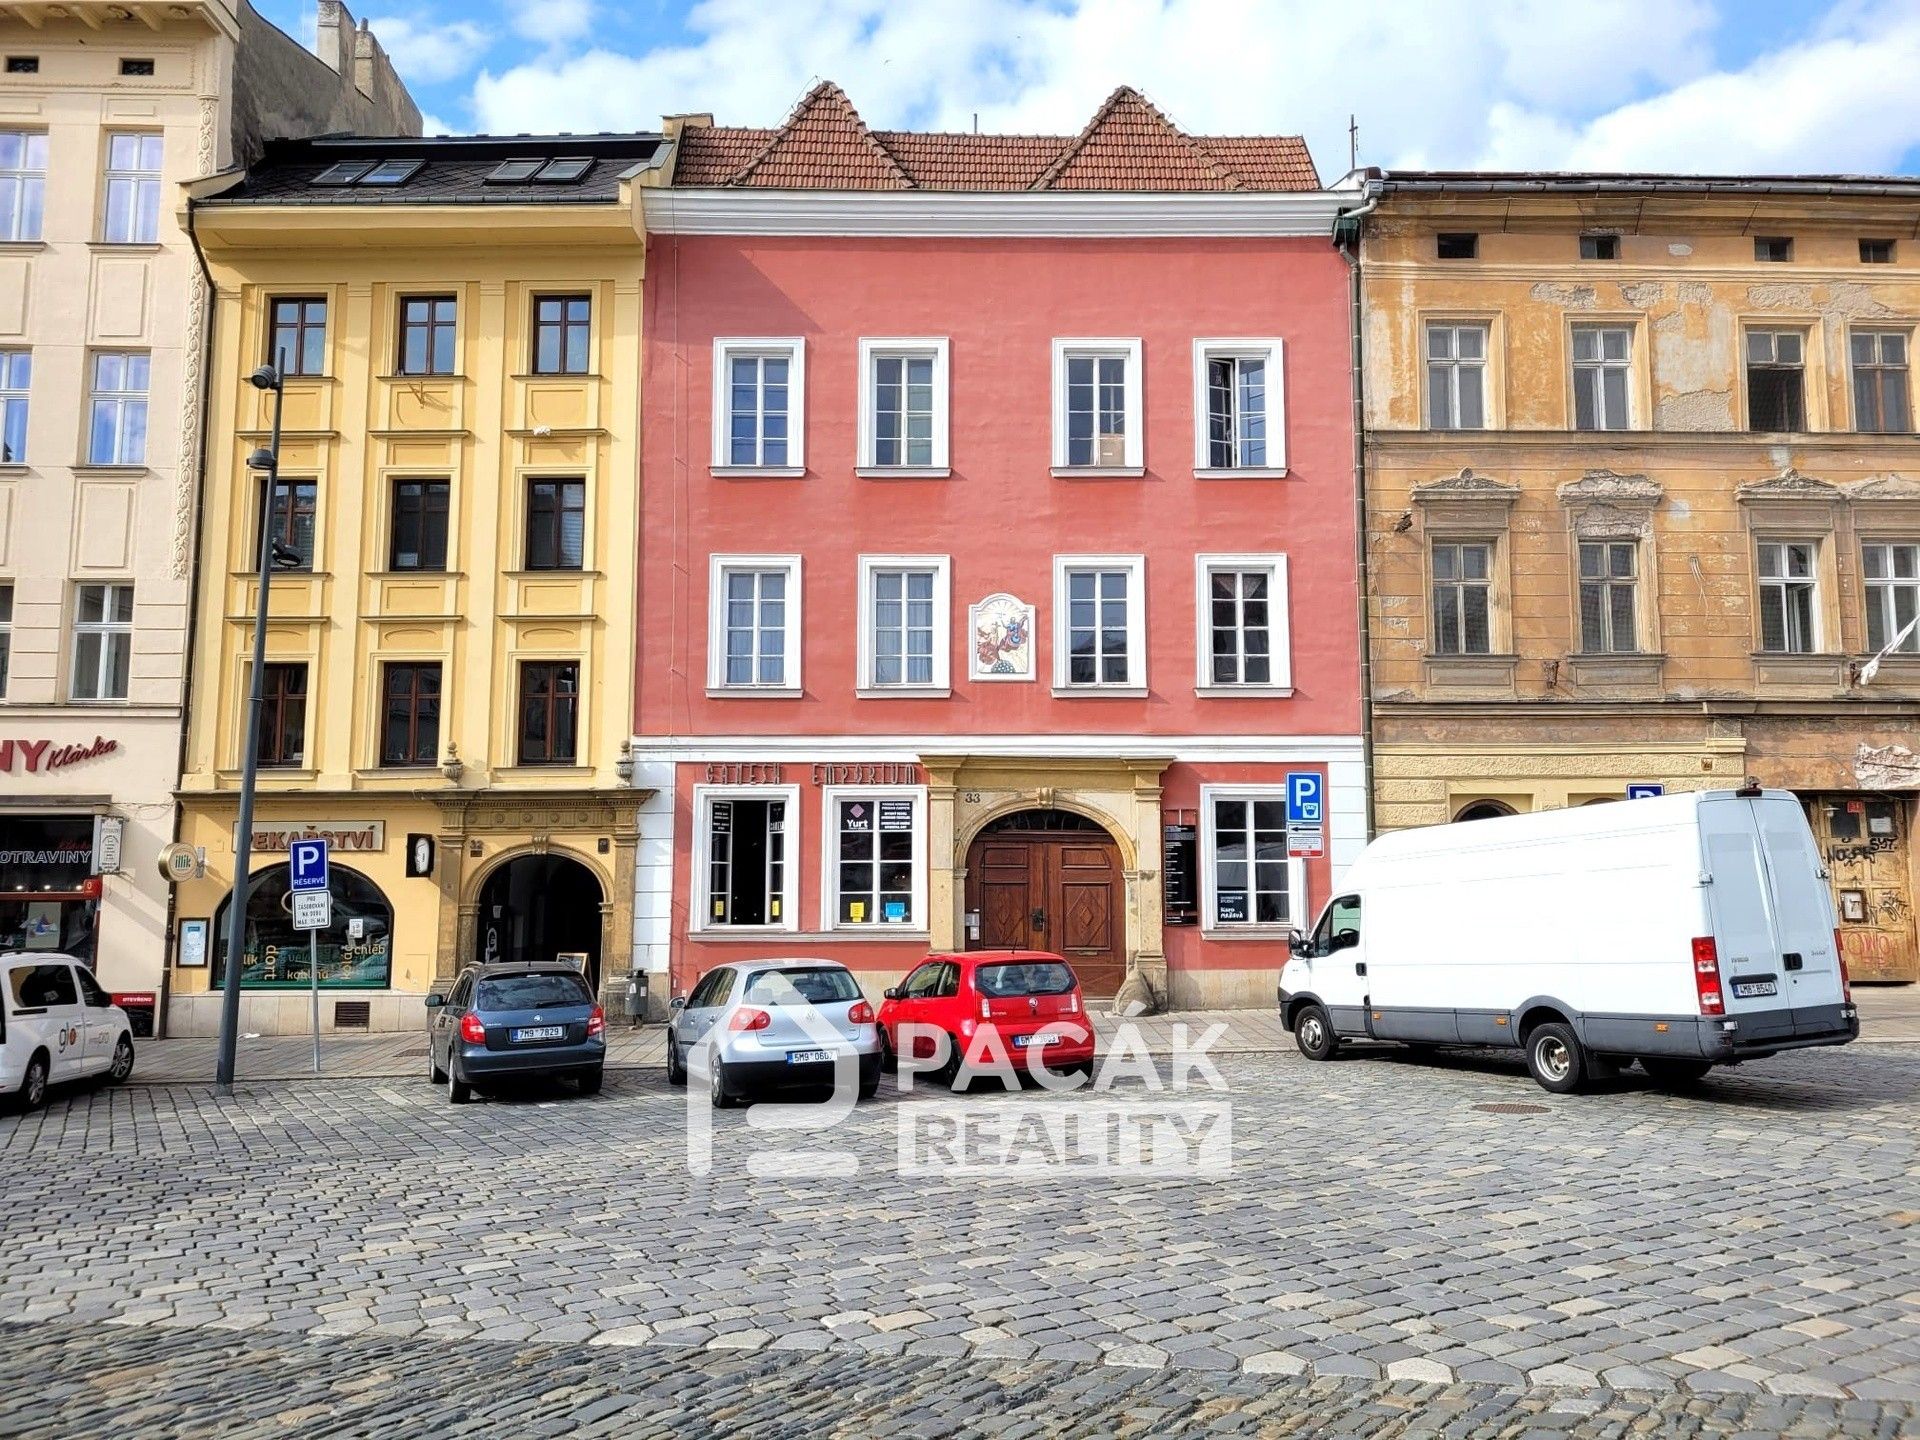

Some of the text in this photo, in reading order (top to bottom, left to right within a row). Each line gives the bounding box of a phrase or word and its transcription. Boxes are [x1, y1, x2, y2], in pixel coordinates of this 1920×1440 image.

[46, 736, 118, 771] Klárka
[706, 763, 916, 785] GANESH EMPORIUM
[965, 793, 980, 803] 33
[1296, 779, 1316, 806] P
[847, 819, 868, 828] Yurt
[251, 825, 376, 849] EKAŘSTVÍ
[299, 846, 319, 876] P
[264, 945, 280, 980] dort
